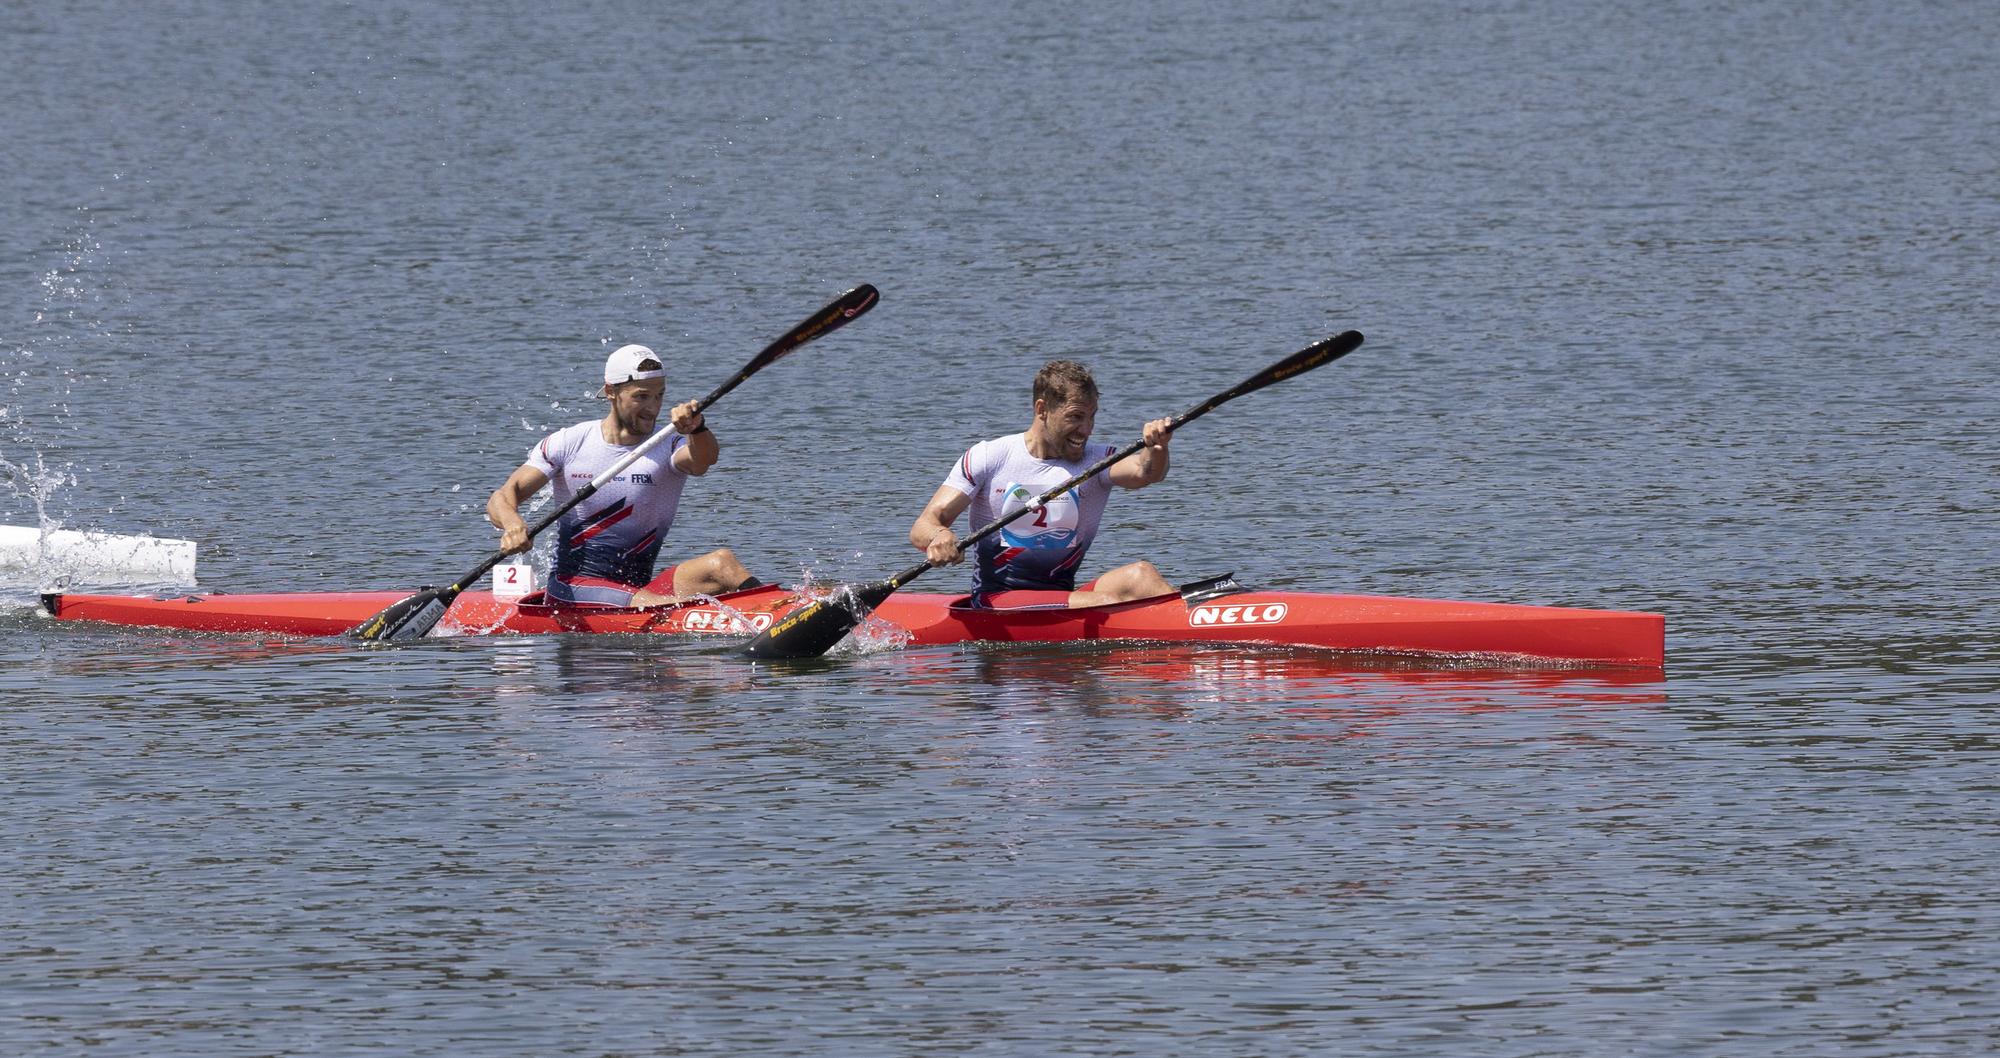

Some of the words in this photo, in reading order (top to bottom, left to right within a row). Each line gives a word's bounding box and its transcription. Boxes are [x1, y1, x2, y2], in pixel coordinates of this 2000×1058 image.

[631, 473, 653, 484] FFCK
[1032, 505, 1048, 528] 2
[507, 567, 517, 584] 2
[1214, 579, 1236, 590] FRA
[1193, 605, 1285, 625] NELO
